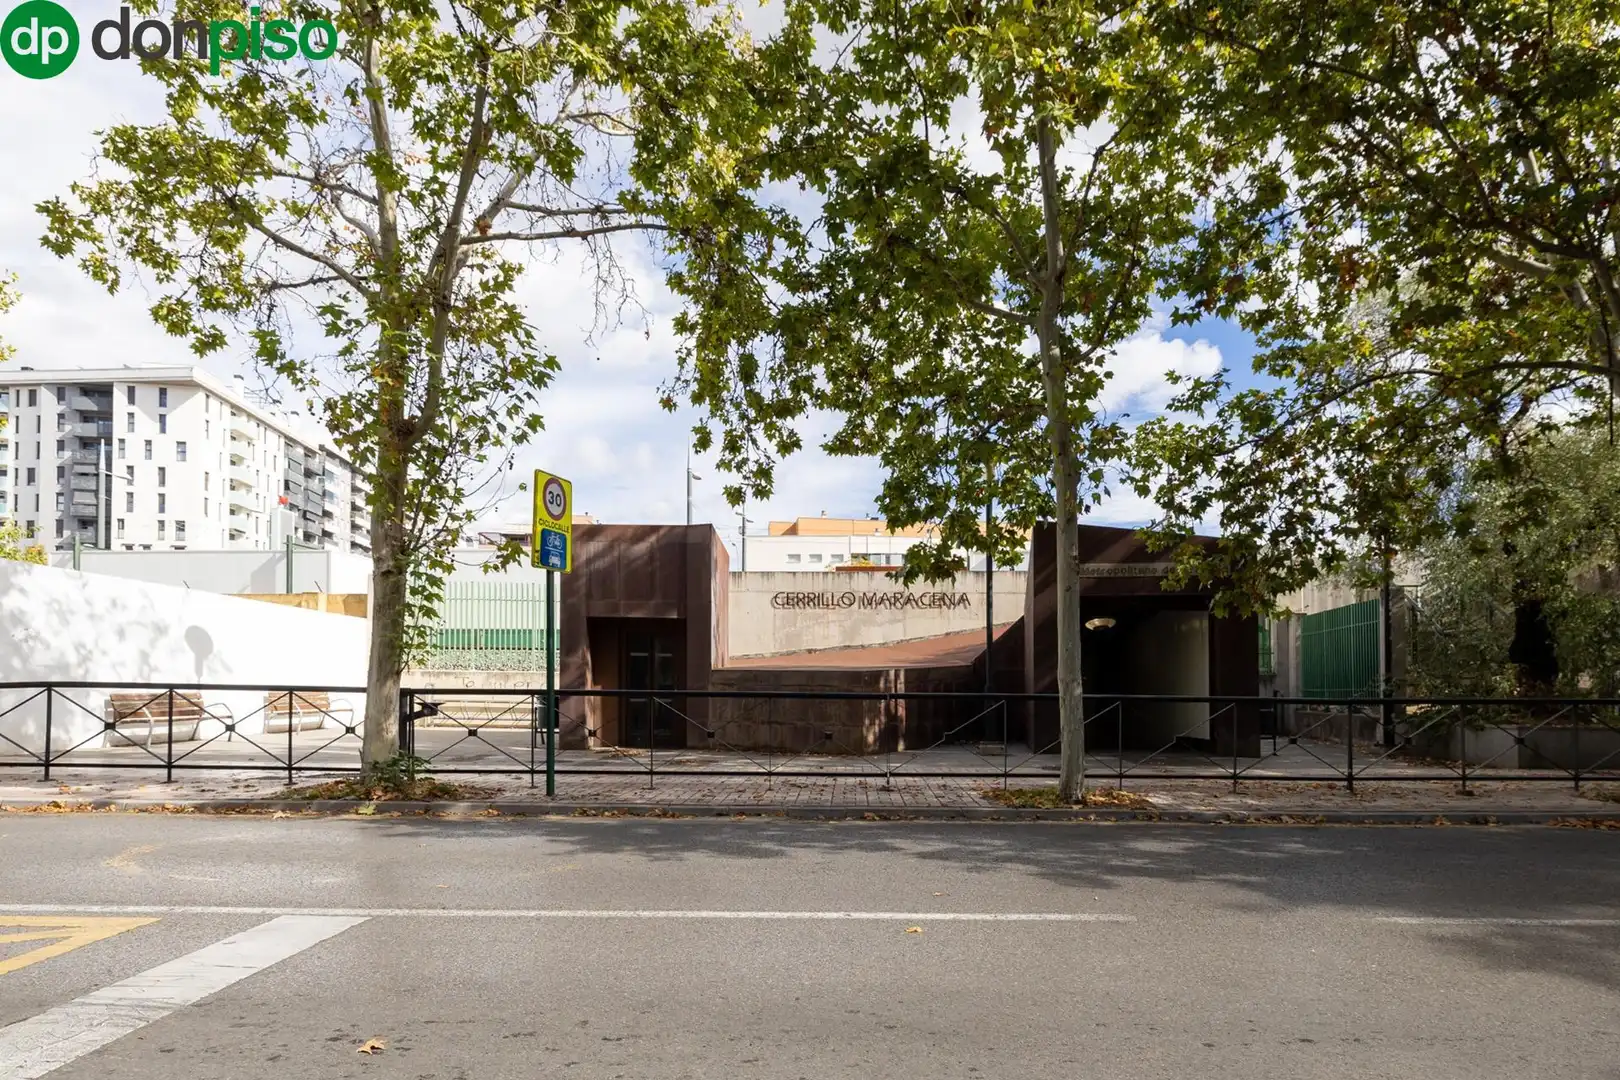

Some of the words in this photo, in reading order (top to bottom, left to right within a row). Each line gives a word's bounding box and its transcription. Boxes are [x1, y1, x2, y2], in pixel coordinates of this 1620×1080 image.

[548, 491, 562, 507] 30
[538, 518, 570, 533] CICLOCALLE
[773, 591, 856, 608] CERRILLO
[861, 591, 971, 609] MARACENA
